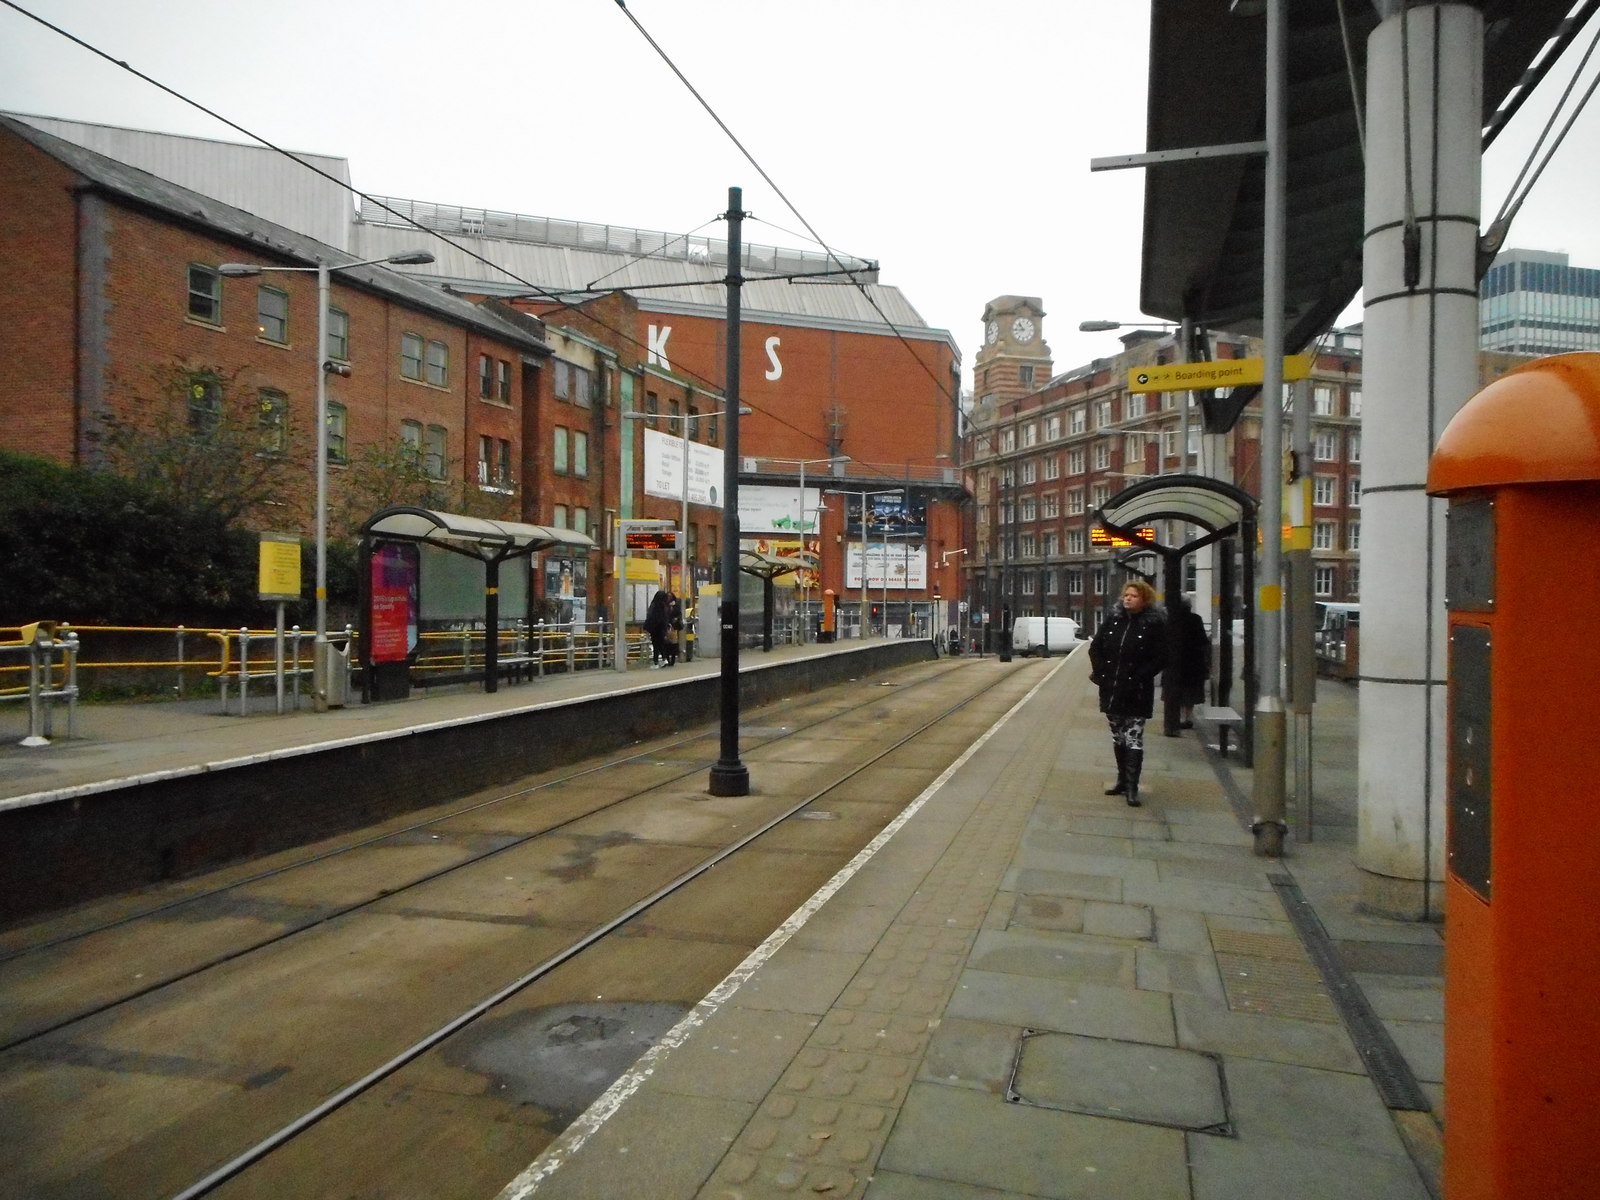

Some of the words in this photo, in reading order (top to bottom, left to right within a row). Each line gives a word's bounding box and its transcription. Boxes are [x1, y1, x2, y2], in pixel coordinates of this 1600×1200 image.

[648, 325, 672, 372] K
[765, 336, 783, 381] S
[1175, 369, 1216, 380] Boarding
[1218, 367, 1243, 378] point
